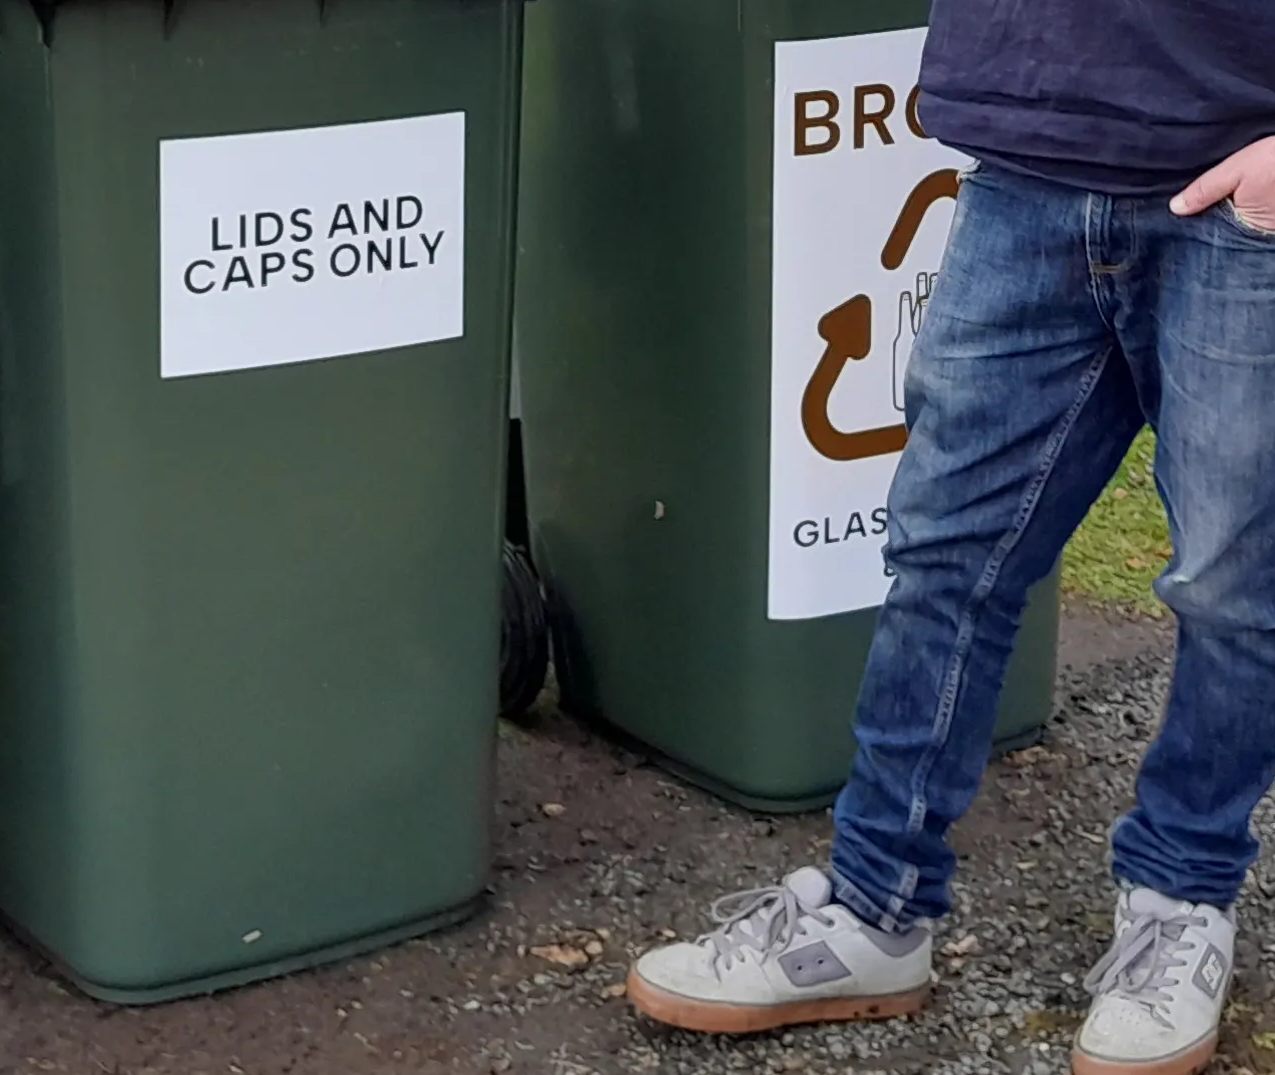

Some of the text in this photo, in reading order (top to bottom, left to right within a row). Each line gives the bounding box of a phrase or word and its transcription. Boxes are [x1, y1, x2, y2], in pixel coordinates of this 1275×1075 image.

[211, 195, 424, 252] LIDS AND
[183, 231, 445, 295] CAPS ONLY
[794, 508, 887, 548] GLAS
